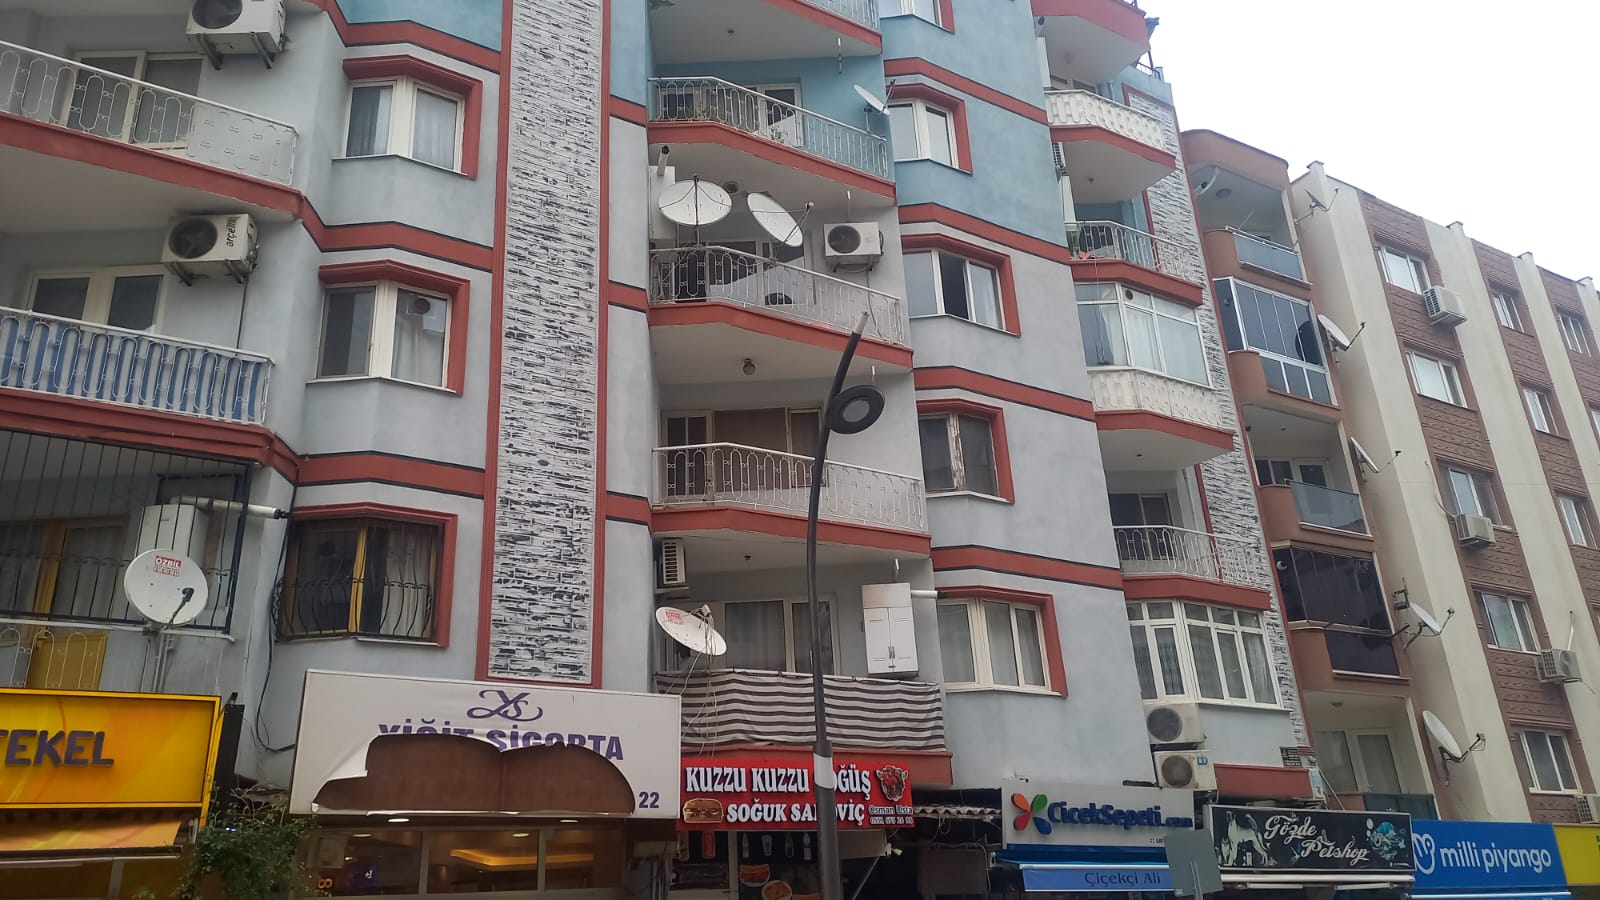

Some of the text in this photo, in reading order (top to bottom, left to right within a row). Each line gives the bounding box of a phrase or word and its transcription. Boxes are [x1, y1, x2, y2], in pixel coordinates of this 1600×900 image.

[685, 766, 747, 792] KUZZU
[751, 767, 810, 792] KUZZU
[638, 791, 660, 809] 22
[726, 798, 865, 826] SOĞUK SAVİÇ
[1263, 815, 1318, 845] Gözde
[1300, 835, 1371, 867] Petshop
[1440, 840, 1552, 873] milli piyango
[1084, 871, 1161, 888] Çiçekçi Ali
